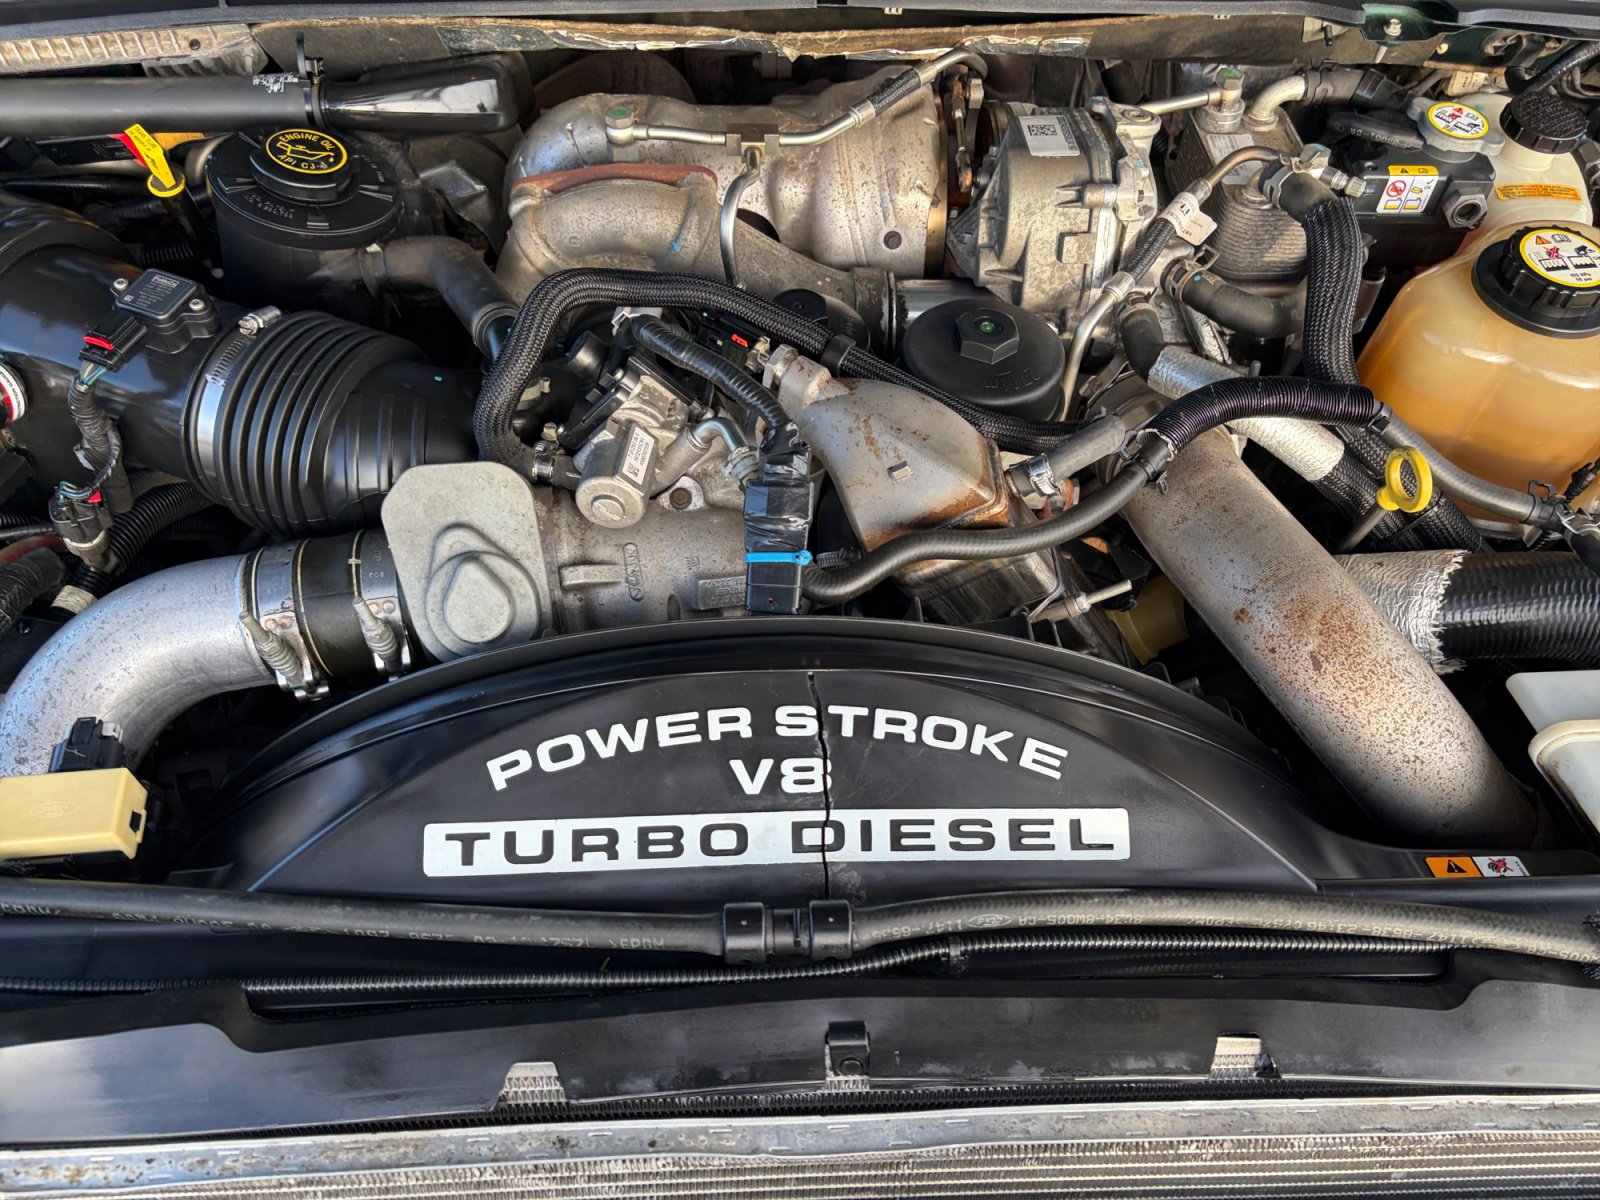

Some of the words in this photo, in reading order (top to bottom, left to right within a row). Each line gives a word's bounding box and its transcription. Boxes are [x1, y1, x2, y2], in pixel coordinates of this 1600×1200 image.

[277, 154, 297, 166] API
[279, 132, 320, 142] ENGINE
[320, 139, 336, 151] OIL
[486, 707, 753, 791] POWER
[775, 705, 1069, 780] STROKE
[729, 757, 833, 795] V8
[445, 822, 749, 867] TURBO
[792, 817, 1115, 853] DIESEL
